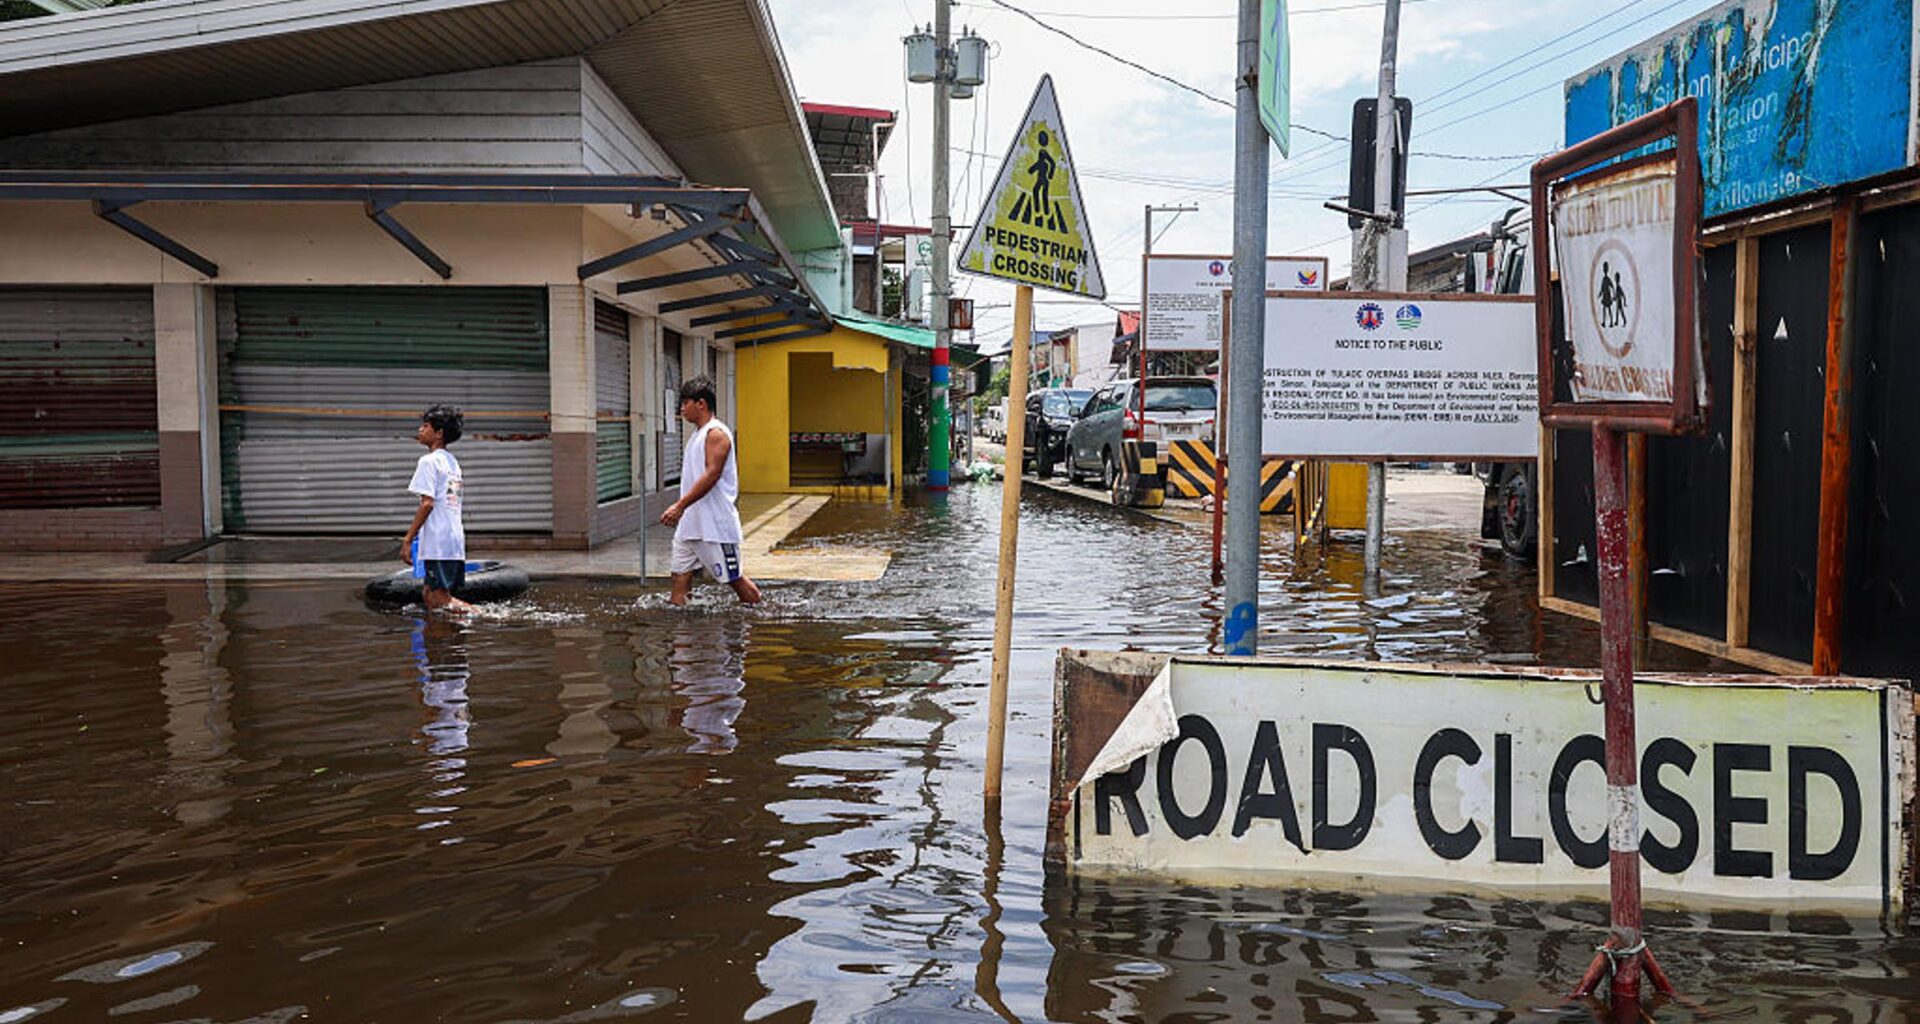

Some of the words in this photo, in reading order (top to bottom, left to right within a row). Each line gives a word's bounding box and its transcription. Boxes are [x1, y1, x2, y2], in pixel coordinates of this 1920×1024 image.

[985, 226, 1088, 265] PEDESTRIAN
[994, 254, 1077, 292] CROSSING
[1335, 340, 1370, 349] NOTICE
[1373, 340, 1386, 349] TO
[1388, 340, 1406, 350] THE
[1409, 340, 1443, 351] PUBLIC
[1316, 369, 1325, 378] OF
[1366, 370, 1409, 379] OVERPASS
[1413, 371, 1442, 379] BRIDGE
[1447, 372, 1478, 380] ACROSS
[1312, 380, 1350, 390] Pampanga
[1385, 381, 1438, 389] DEPARTMENT
[1459, 382, 1488, 390] PUBLIC
[1493, 382, 1521, 390] WORKS
[1273, 391, 1312, 399] REGIONAL
[1315, 391, 1343, 399] OFFICE
[1372, 391, 1384, 399] has
[1387, 391, 1405, 399] been
[1408, 392, 1432, 400] issued
[1447, 392, 1498, 401] Environmental
[1501, 392, 1537, 402] Complianc
[1365, 403, 1373, 411] by
[1378, 402, 1389, 410] the
[1393, 402, 1435, 412] Department
[1438, 402, 1447, 410] of
[1450, 402, 1495, 411] Environment
[1274, 411, 1326, 419] Environmental
[1328, 411, 1373, 421] Management
[1376, 412, 1401, 420] Bureau
[1095, 714, 1377, 853] ROAD
[1413, 728, 1862, 880] CLOSED
